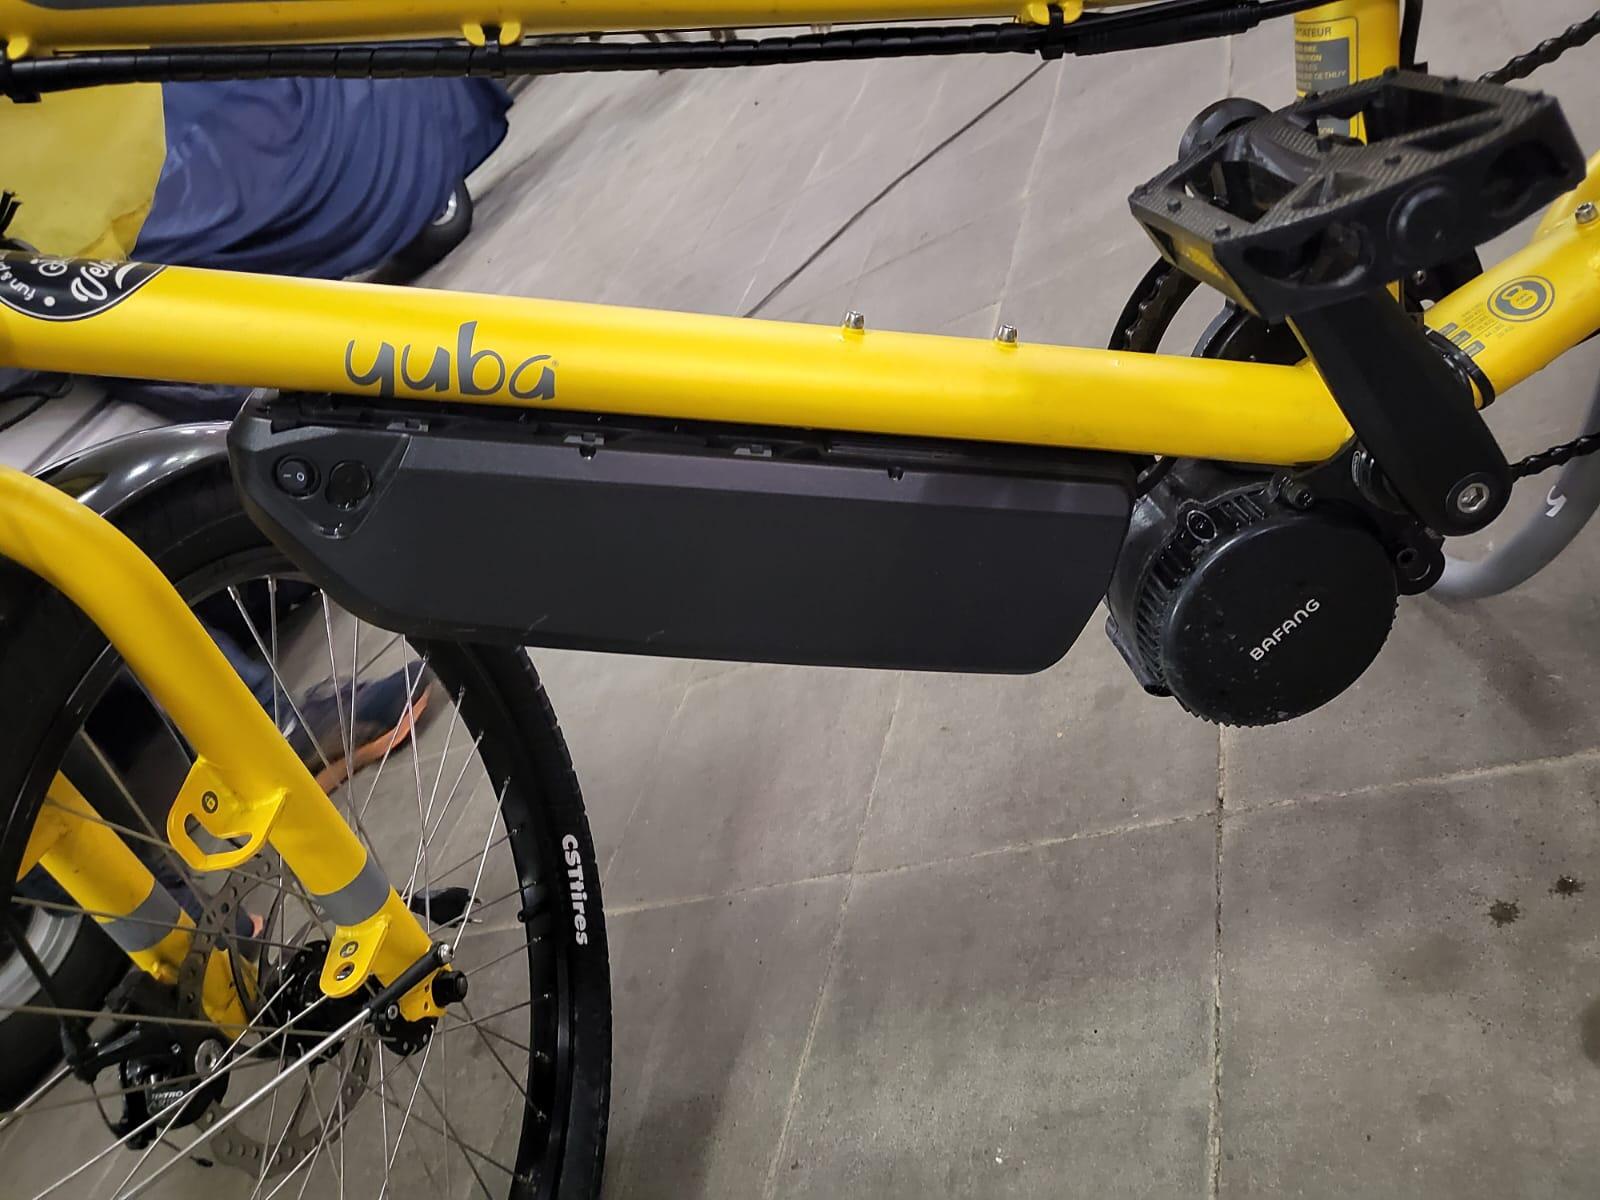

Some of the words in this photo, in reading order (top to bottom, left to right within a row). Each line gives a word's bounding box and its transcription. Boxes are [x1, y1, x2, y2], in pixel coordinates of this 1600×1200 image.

[345, 321, 555, 400] yuba
[1249, 598, 1321, 661] BAFANG
[561, 833, 589, 946] CSTtires
